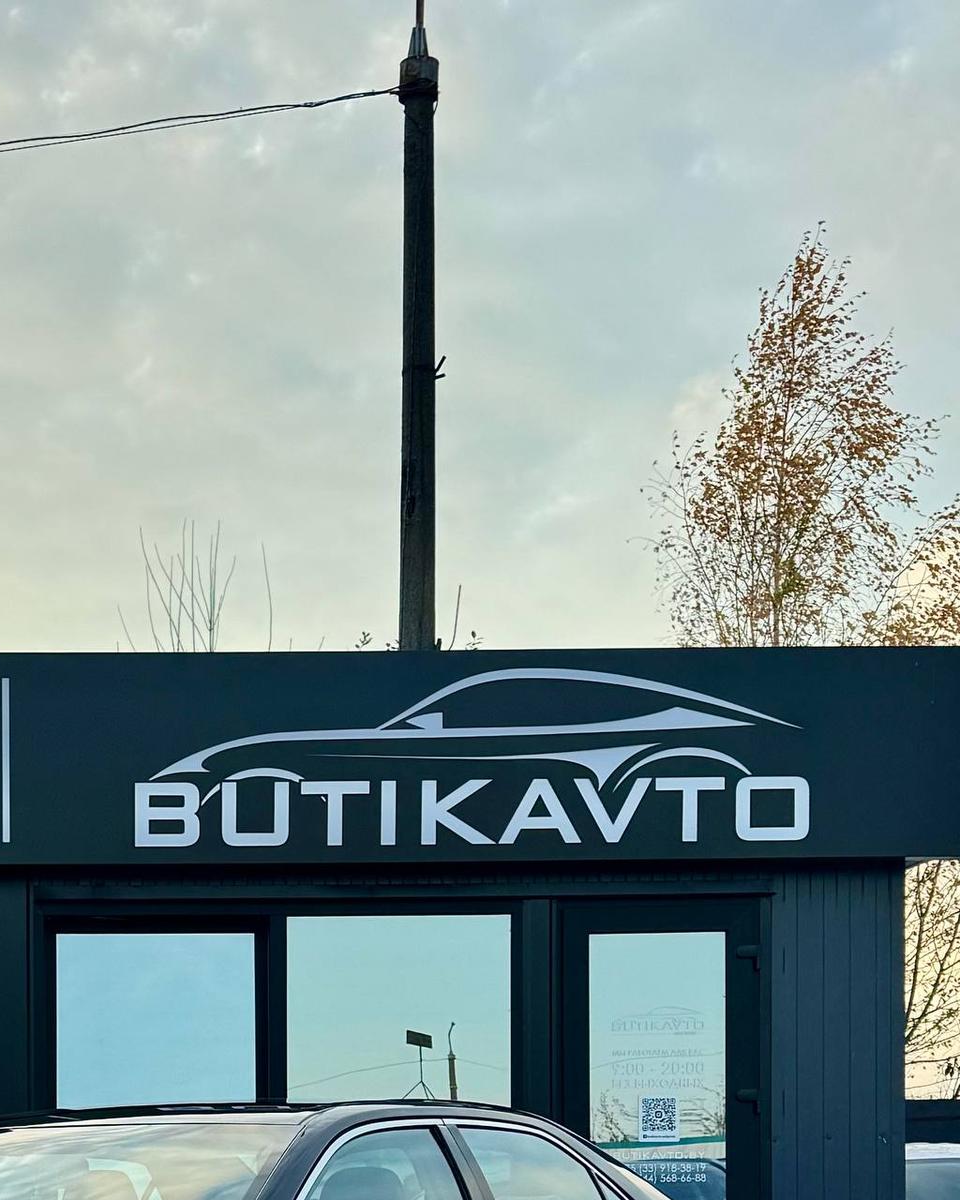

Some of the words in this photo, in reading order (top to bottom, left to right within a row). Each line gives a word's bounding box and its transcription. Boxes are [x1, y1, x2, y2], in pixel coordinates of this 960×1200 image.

[134, 776, 810, 848] BUTIKAVTO
[660, 1061, 705, 1076] 20:00
[639, 1162, 657, 1173] (33)
[659, 1163, 707, 1173] 918-38-19
[660, 1173, 707, 1183] 568-66-88
